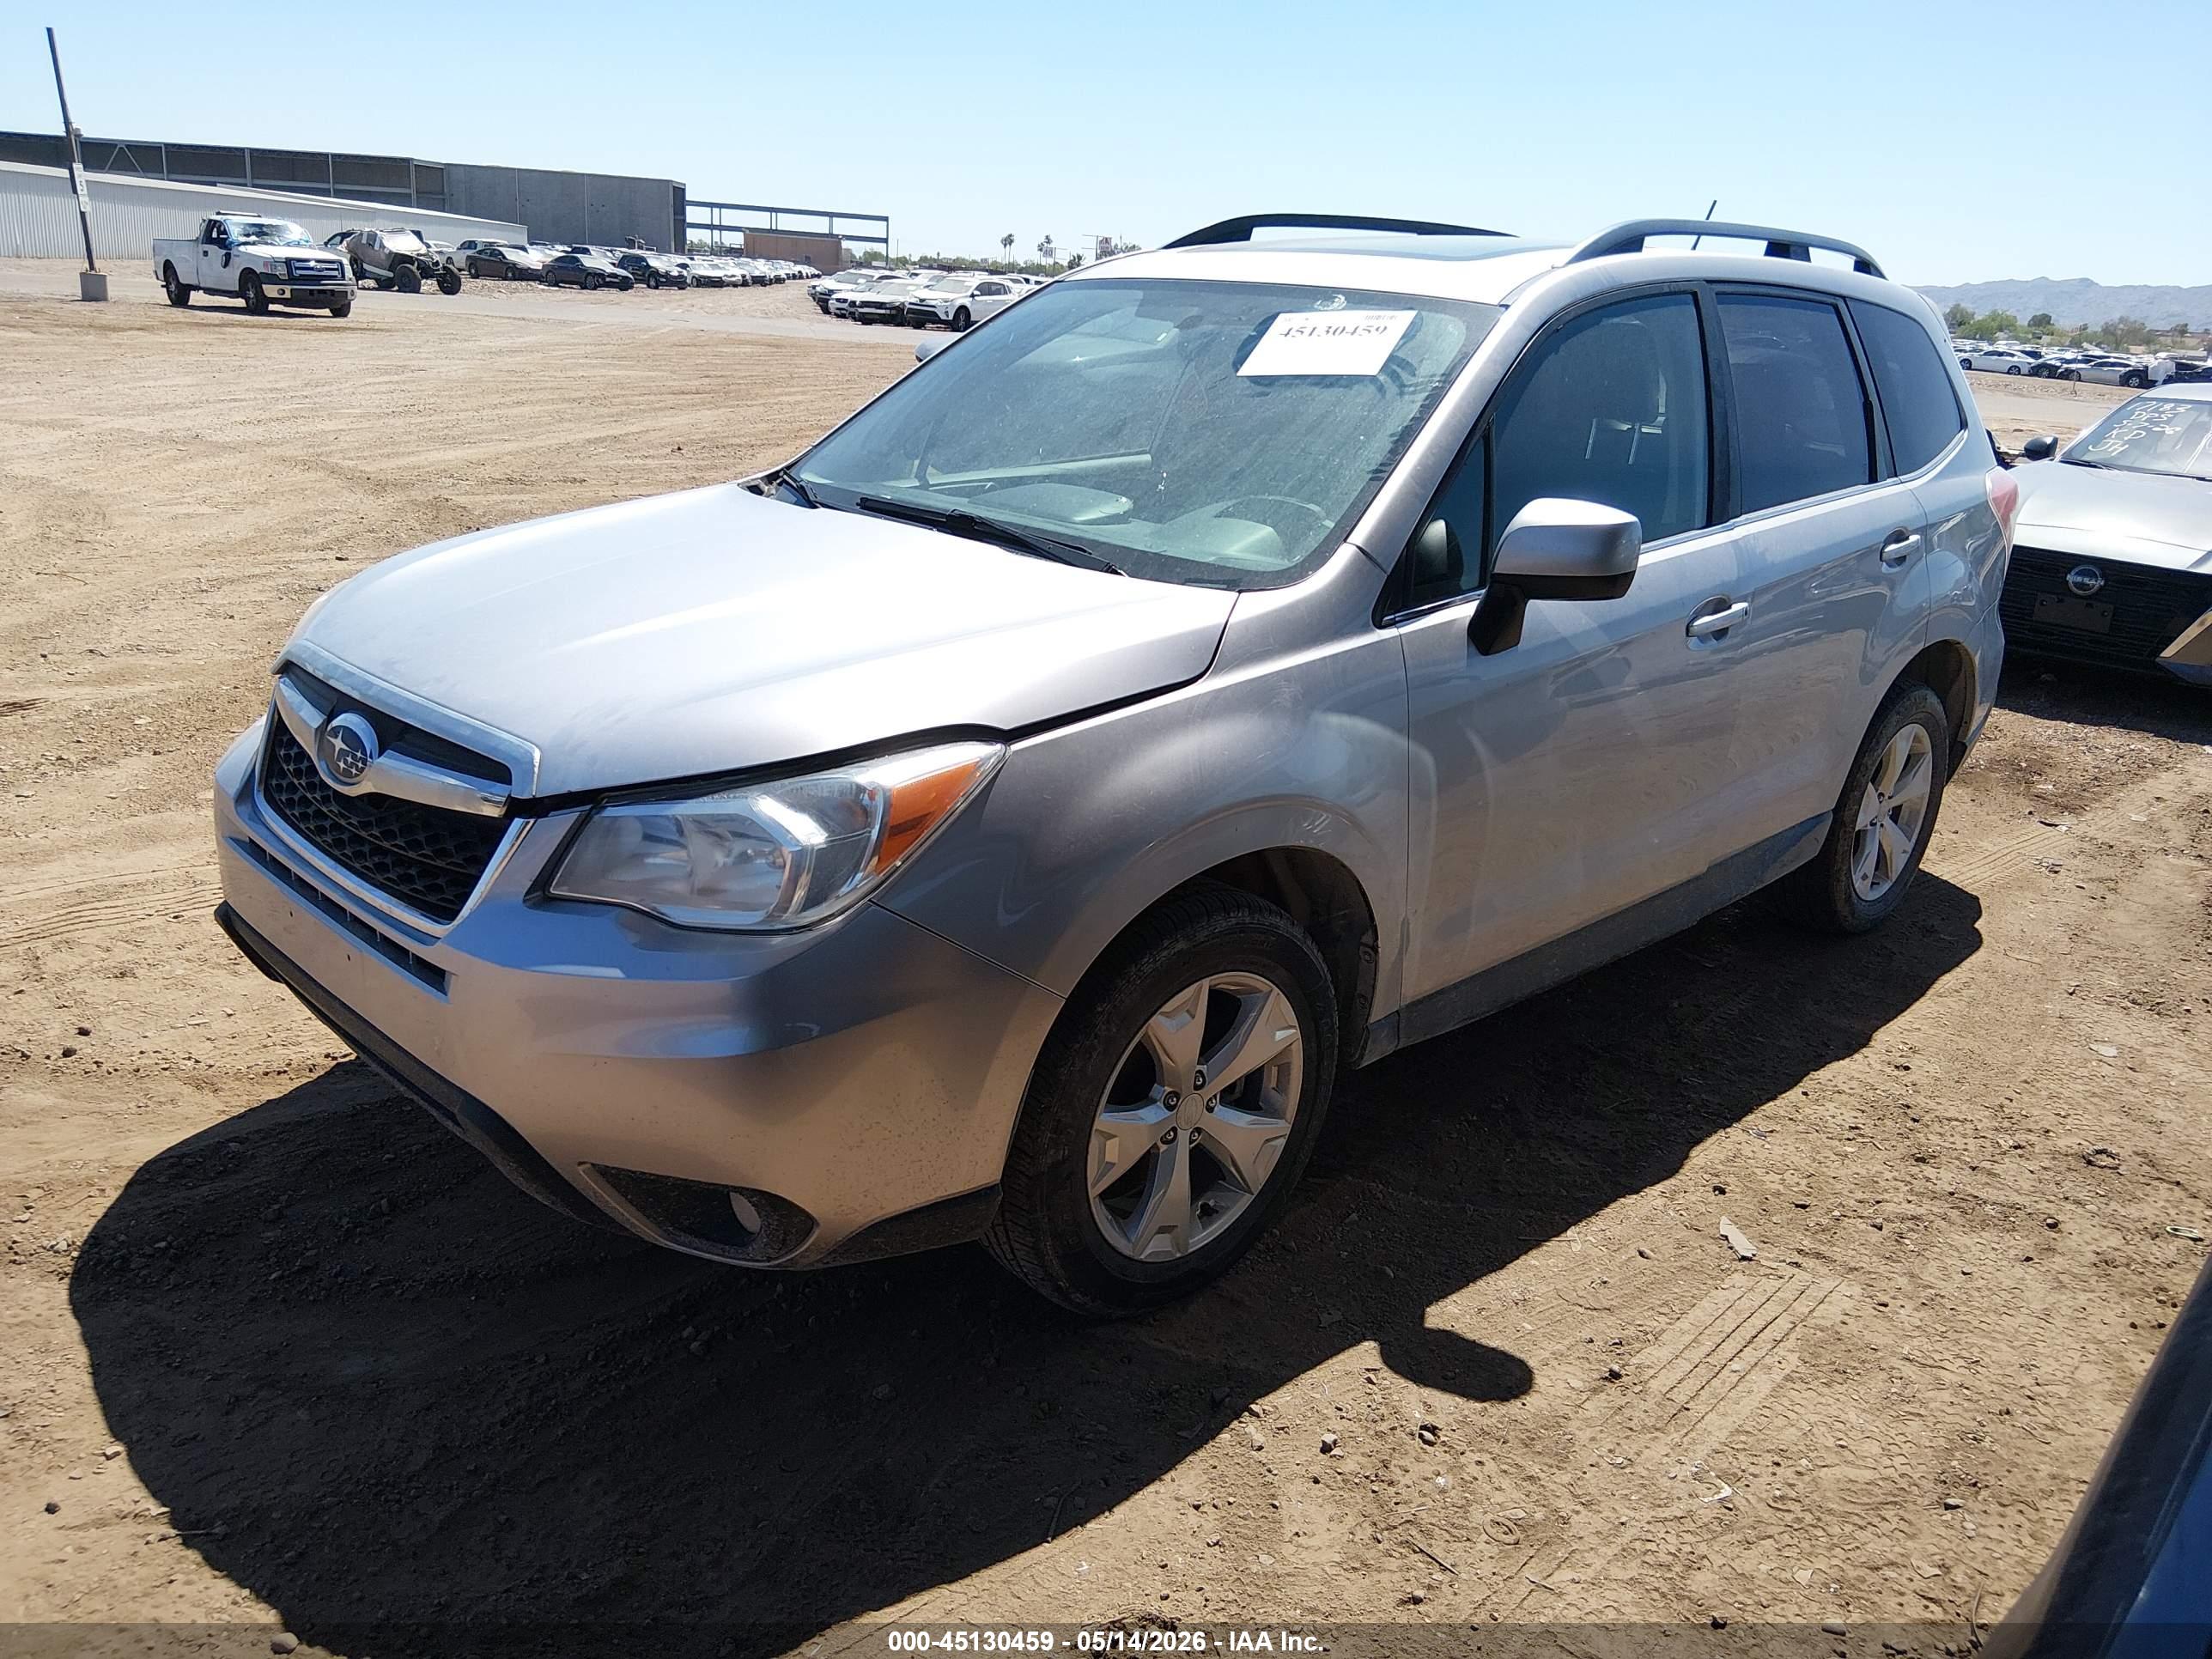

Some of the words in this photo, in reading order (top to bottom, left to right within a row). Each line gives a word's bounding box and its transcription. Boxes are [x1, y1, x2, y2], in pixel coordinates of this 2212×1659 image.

[1279, 325, 1388, 337] 45130459
[2130, 410, 2174, 422] DPS
[2087, 440, 2130, 456] JH
